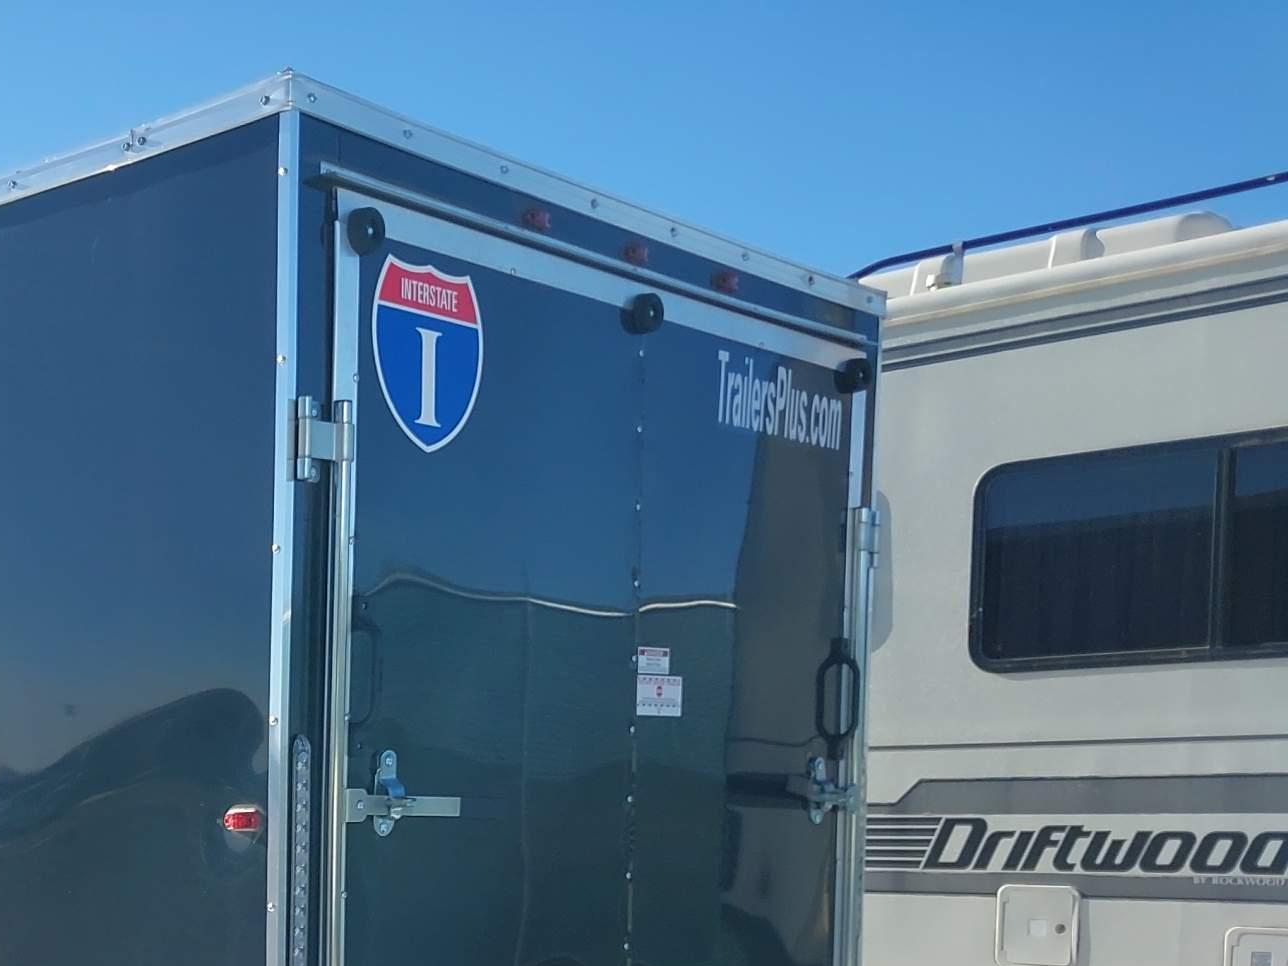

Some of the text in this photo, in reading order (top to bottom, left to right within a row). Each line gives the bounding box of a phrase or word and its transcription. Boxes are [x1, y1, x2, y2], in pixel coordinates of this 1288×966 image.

[401, 277, 458, 312] INTERSTATE
[414, 326, 443, 428] I
[718, 349, 842, 451] TrailersPlus.com
